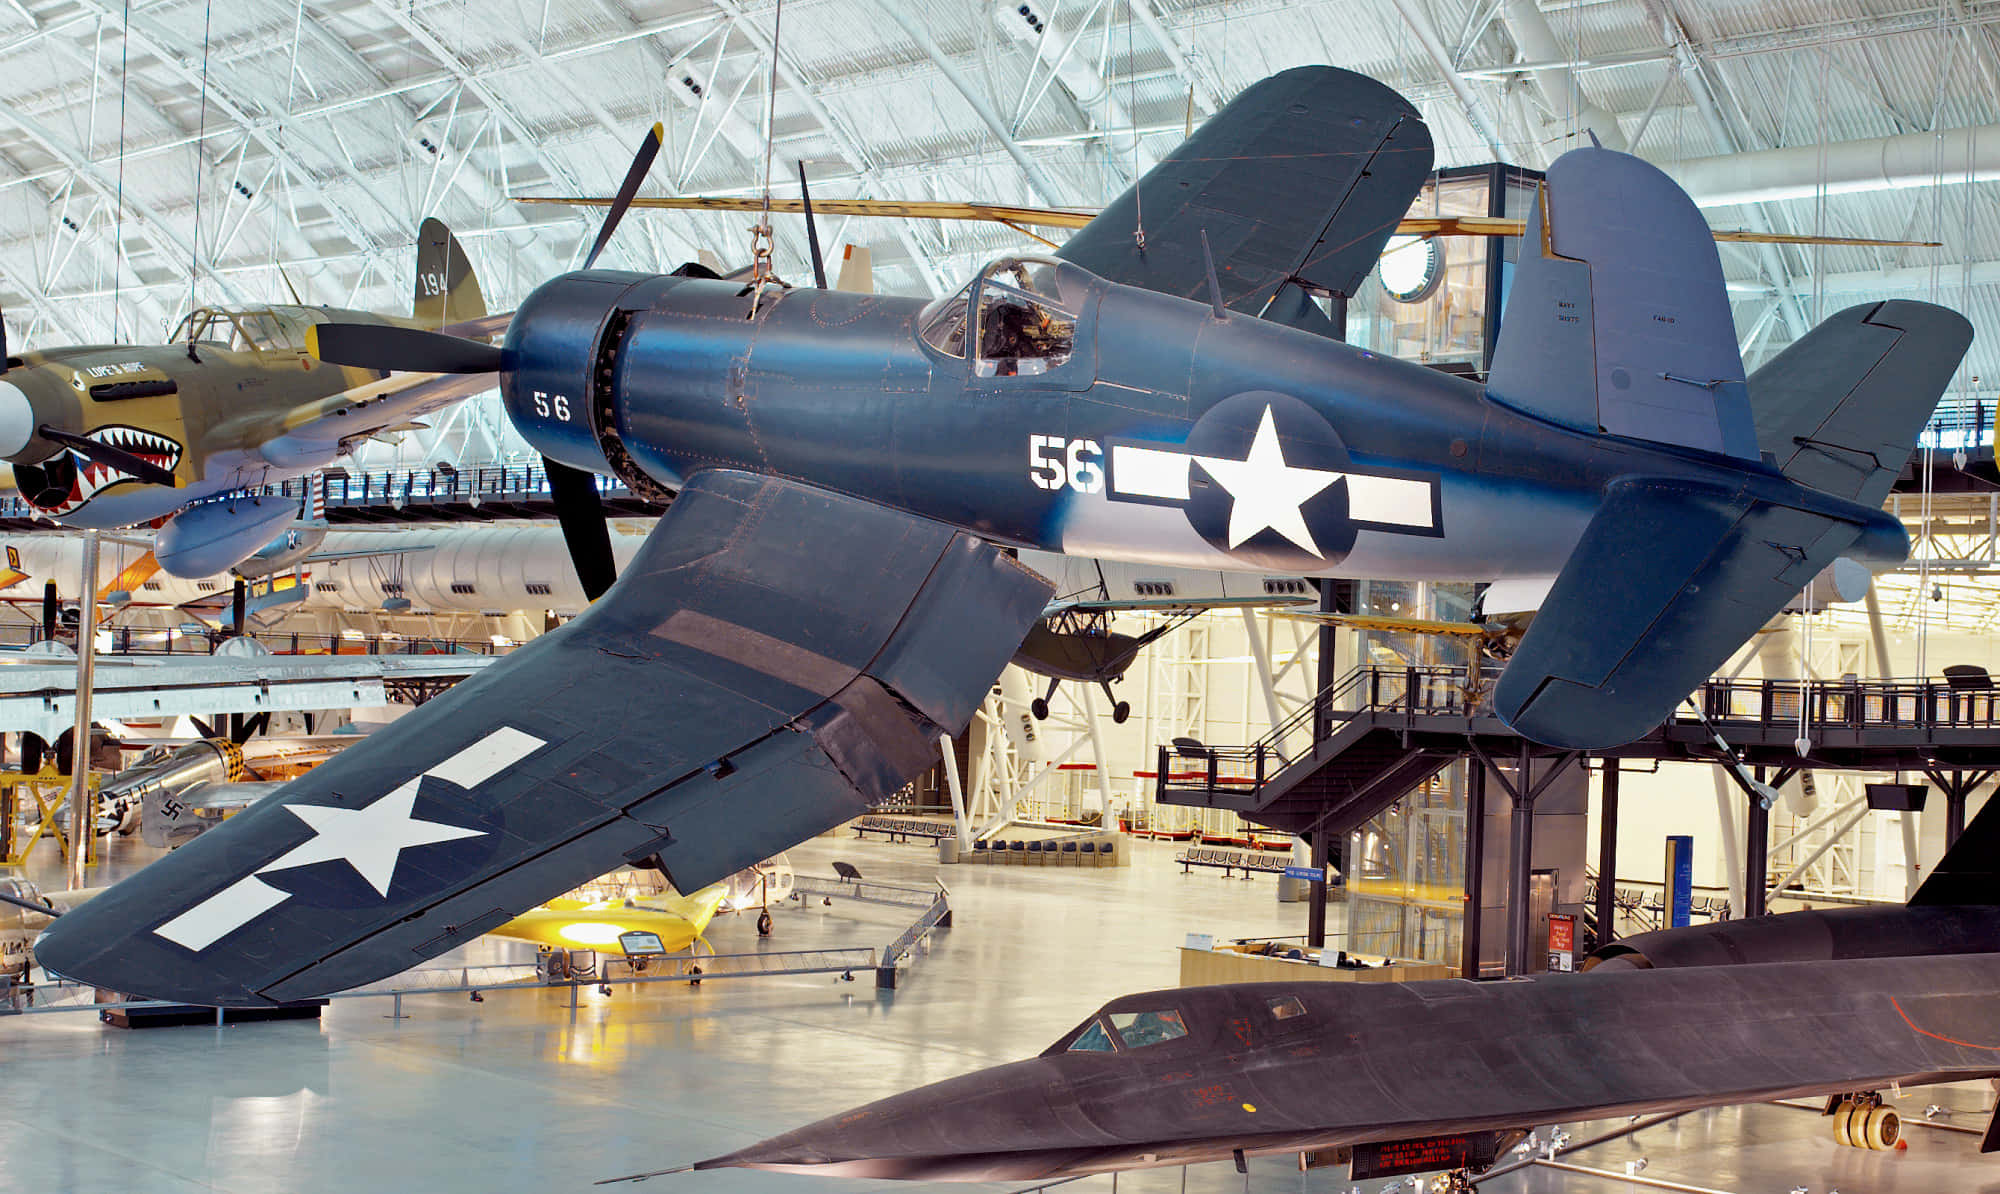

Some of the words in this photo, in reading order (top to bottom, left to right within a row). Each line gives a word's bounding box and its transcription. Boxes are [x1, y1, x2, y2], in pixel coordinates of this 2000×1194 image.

[420, 272, 448, 295] 194
[533, 391, 571, 422] 56
[1030, 434, 1104, 495] 56
